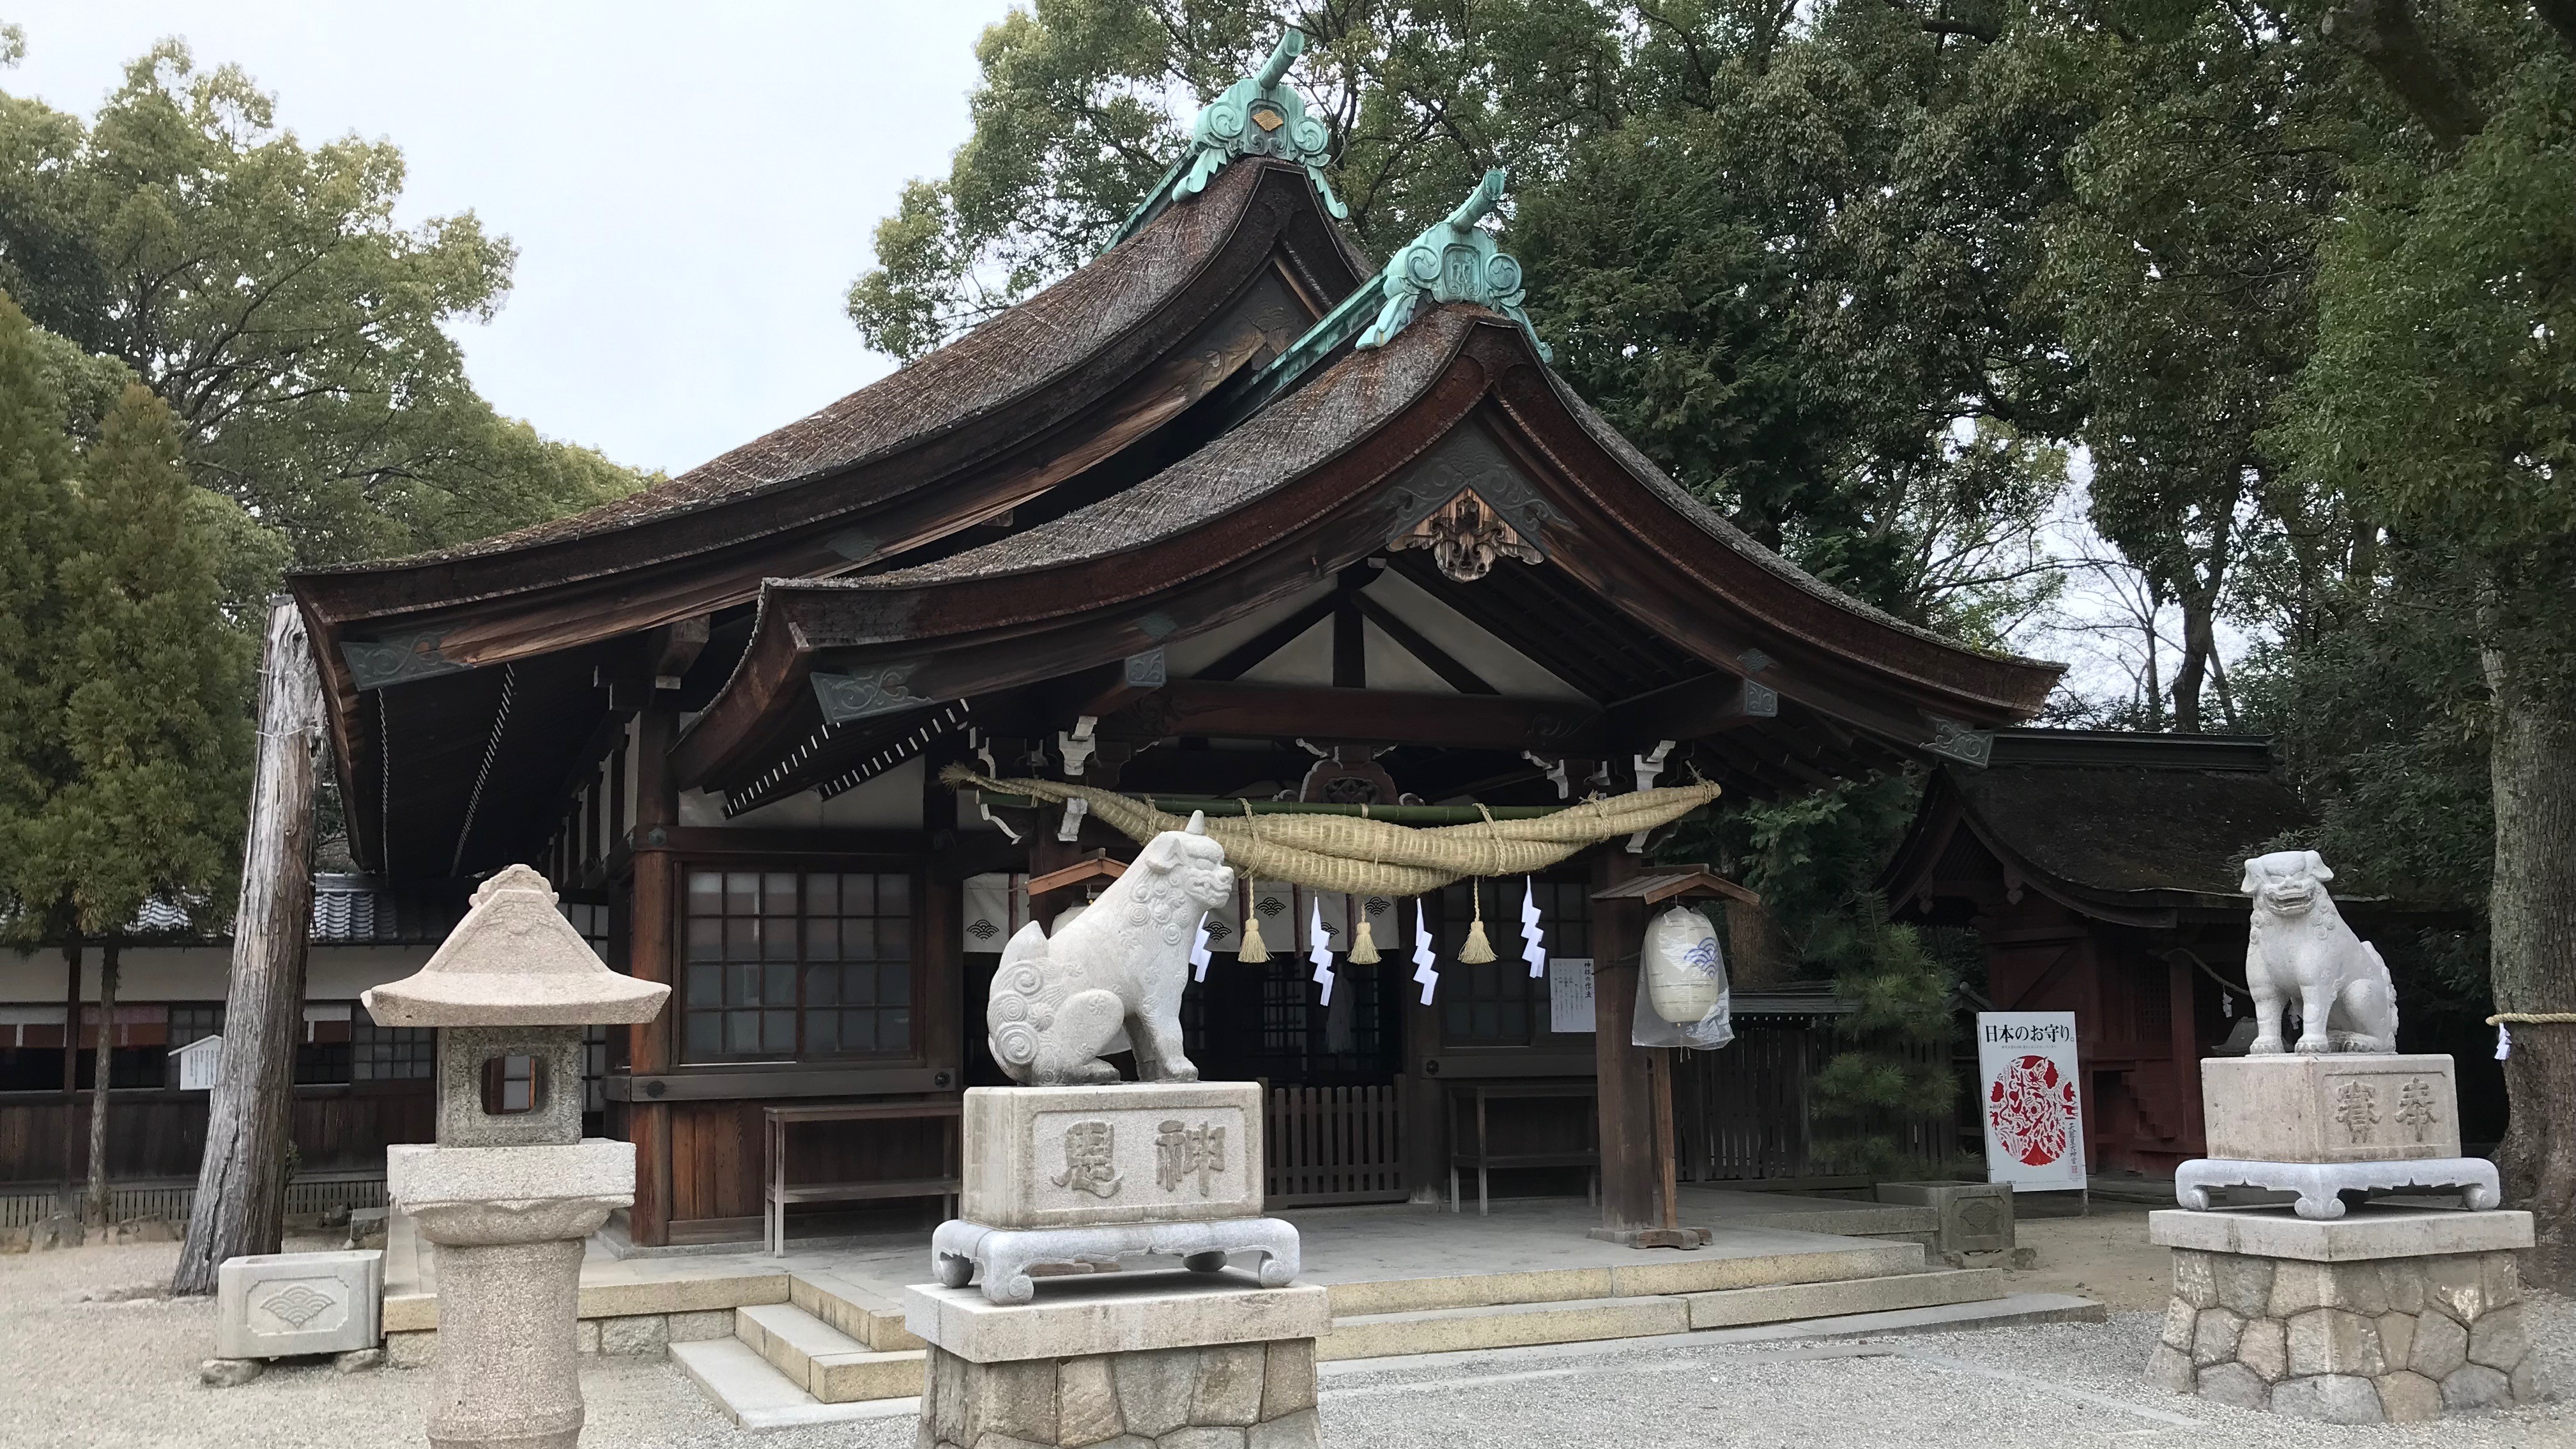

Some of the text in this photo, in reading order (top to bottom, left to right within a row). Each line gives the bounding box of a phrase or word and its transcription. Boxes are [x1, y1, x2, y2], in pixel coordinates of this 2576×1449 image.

[1986, 1024, 2074, 1043] 日本のお守り。
